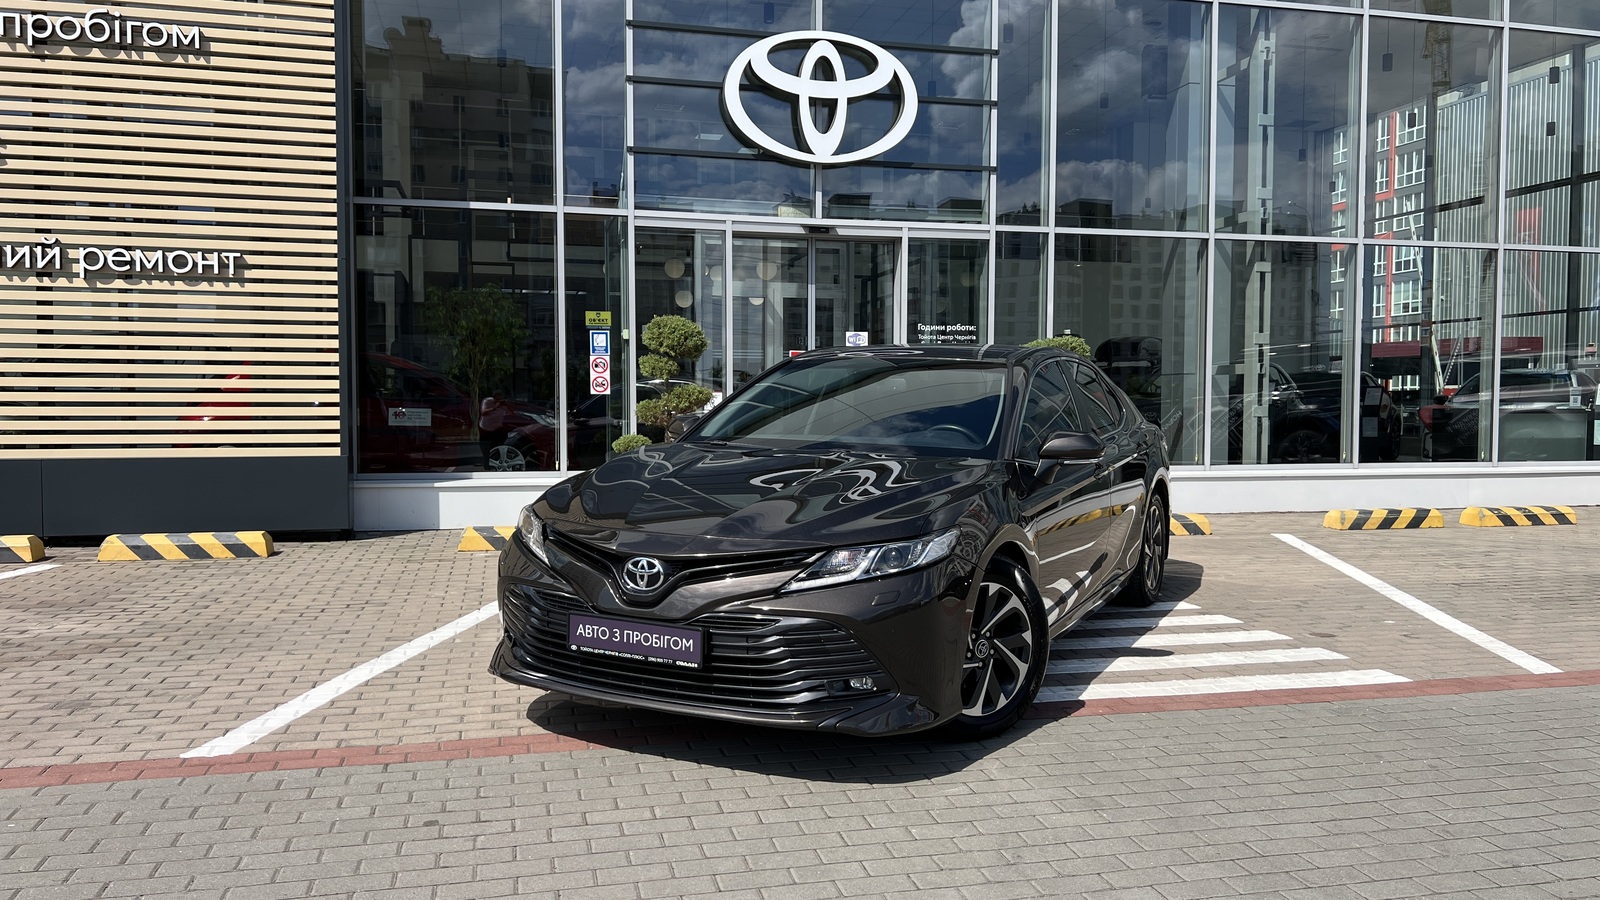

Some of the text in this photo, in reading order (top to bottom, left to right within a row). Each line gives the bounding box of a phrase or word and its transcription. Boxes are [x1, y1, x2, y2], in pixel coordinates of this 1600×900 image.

[0, 8, 201, 49] пробігом
[78, 246, 242, 279] ремонт
[917, 323, 977, 333] Години роботи:
[576, 623, 610, 640] АВТО
[623, 630, 694, 652] ПРОБІГОМ
